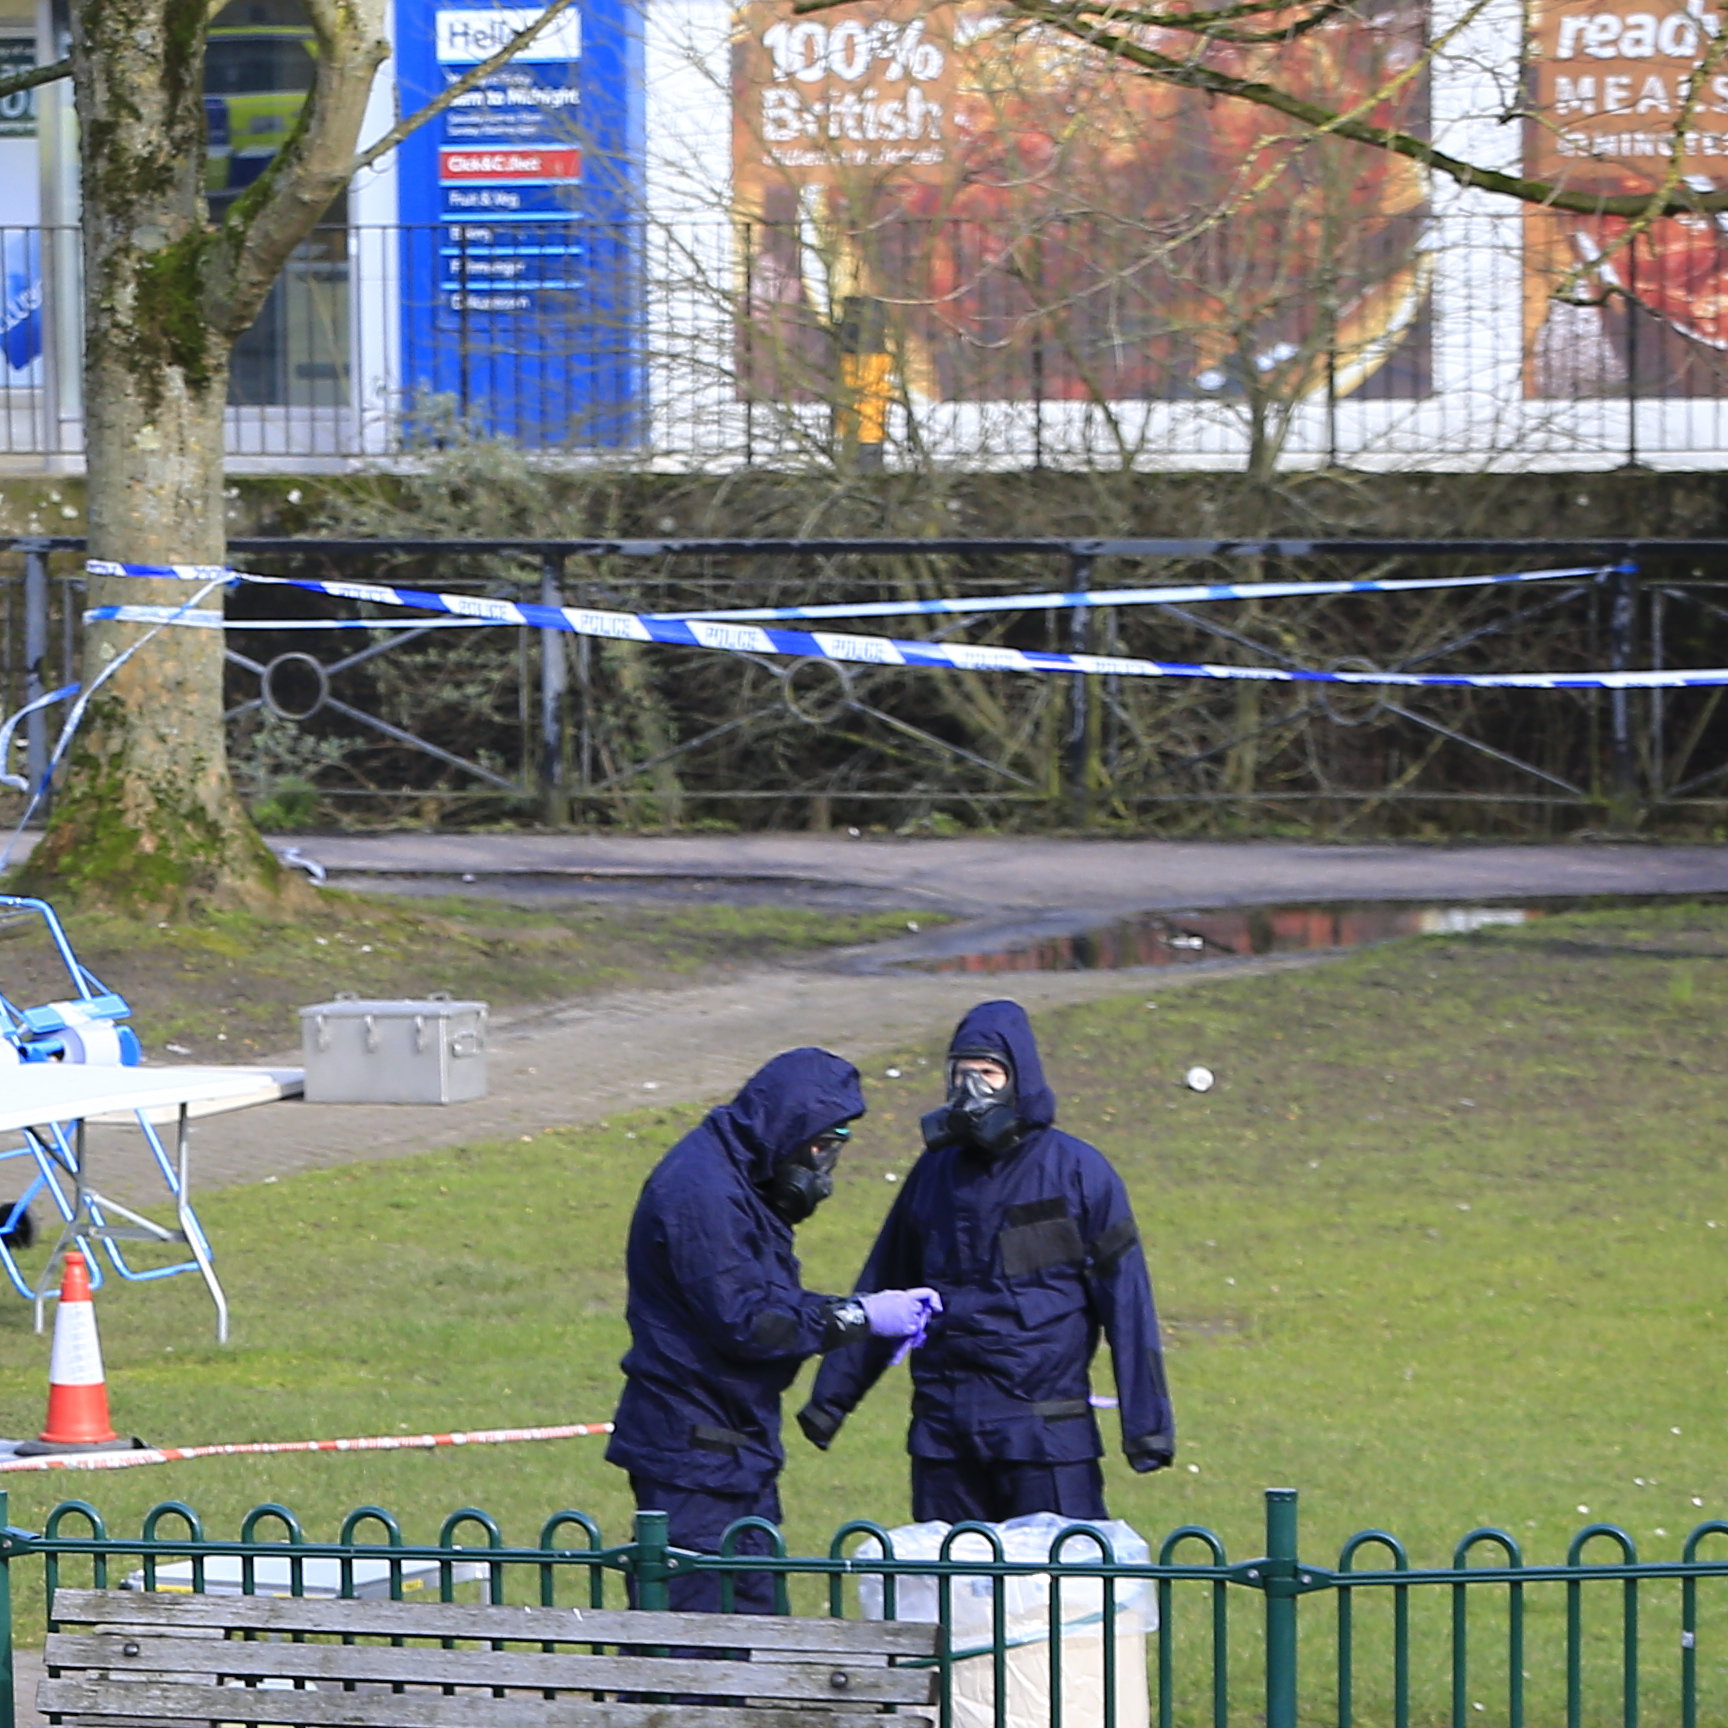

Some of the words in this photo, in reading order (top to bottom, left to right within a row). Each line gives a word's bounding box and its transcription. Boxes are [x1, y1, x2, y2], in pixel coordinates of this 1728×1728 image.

[761, 18, 945, 82] 100%
[761, 85, 944, 141] British
[580, 613, 632, 638] POLICE
